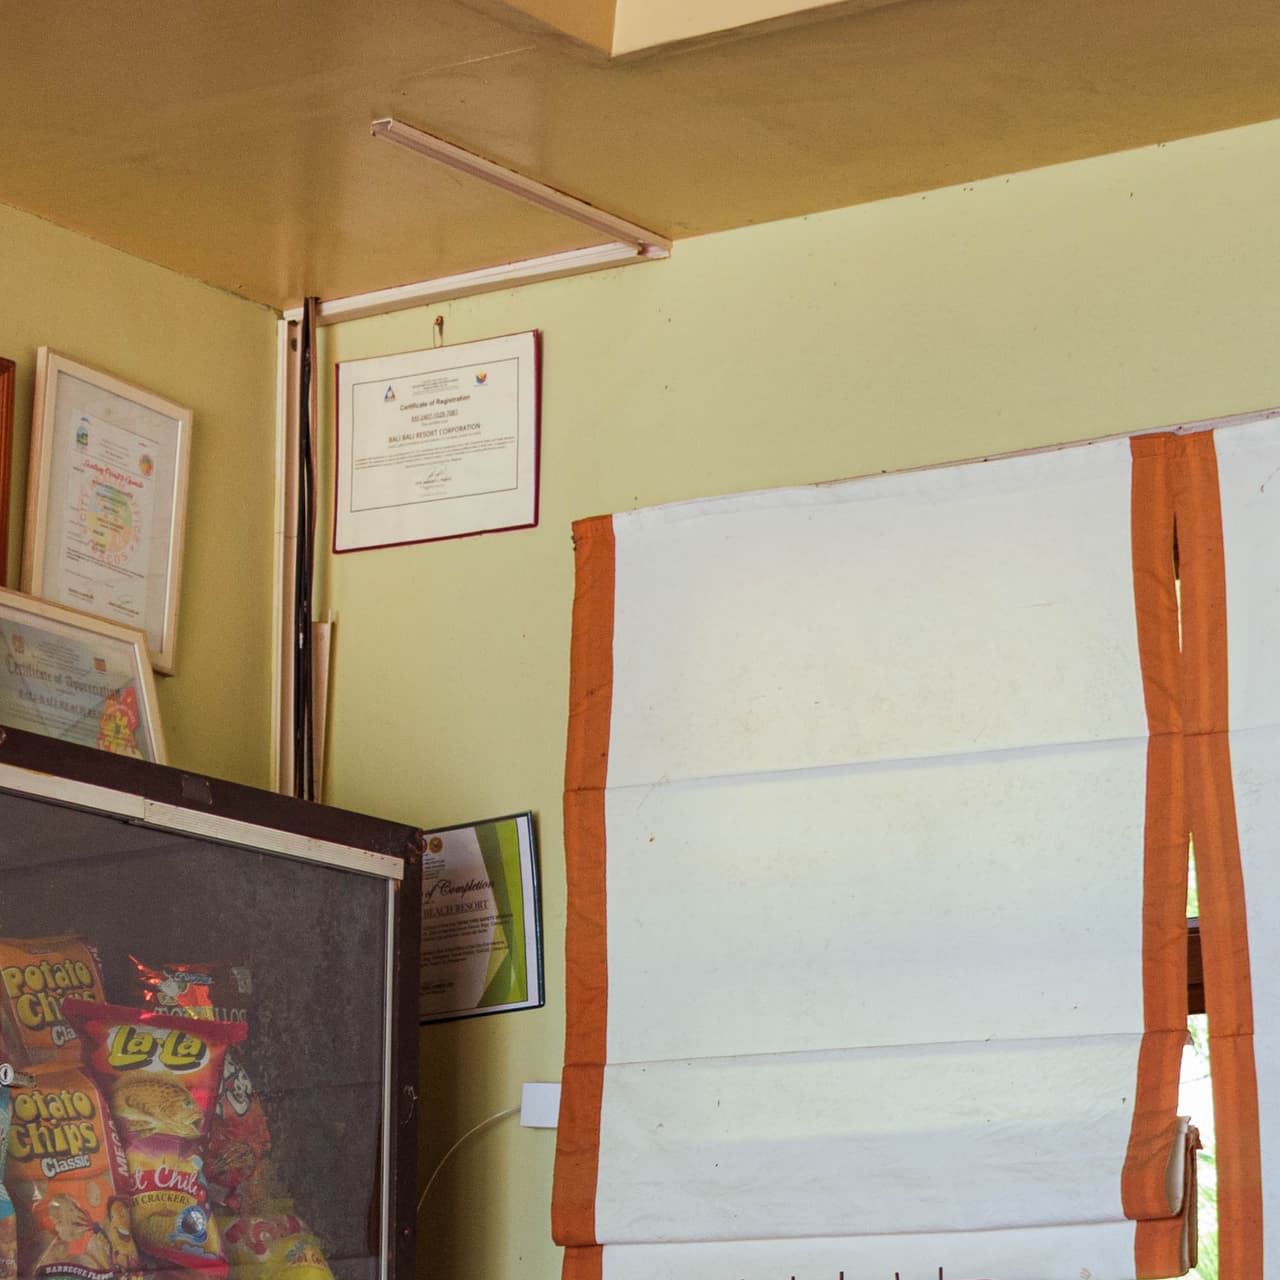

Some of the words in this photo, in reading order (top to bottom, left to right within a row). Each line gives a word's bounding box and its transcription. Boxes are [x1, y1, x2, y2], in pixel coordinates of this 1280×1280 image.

[416, 429, 438, 438] RESORT
[439, 423, 481, 436] CORPORATION
[437, 878, 495, 898] Completion
[2, 959, 93, 999] Potato
[14, 1089, 96, 1122] otato
[8, 1118, 100, 1161] Chips
[40, 1152, 92, 1178] Classic
[141, 1193, 191, 1205] CRACKERS
[45, 1265, 87, 1278] BARBECUE
